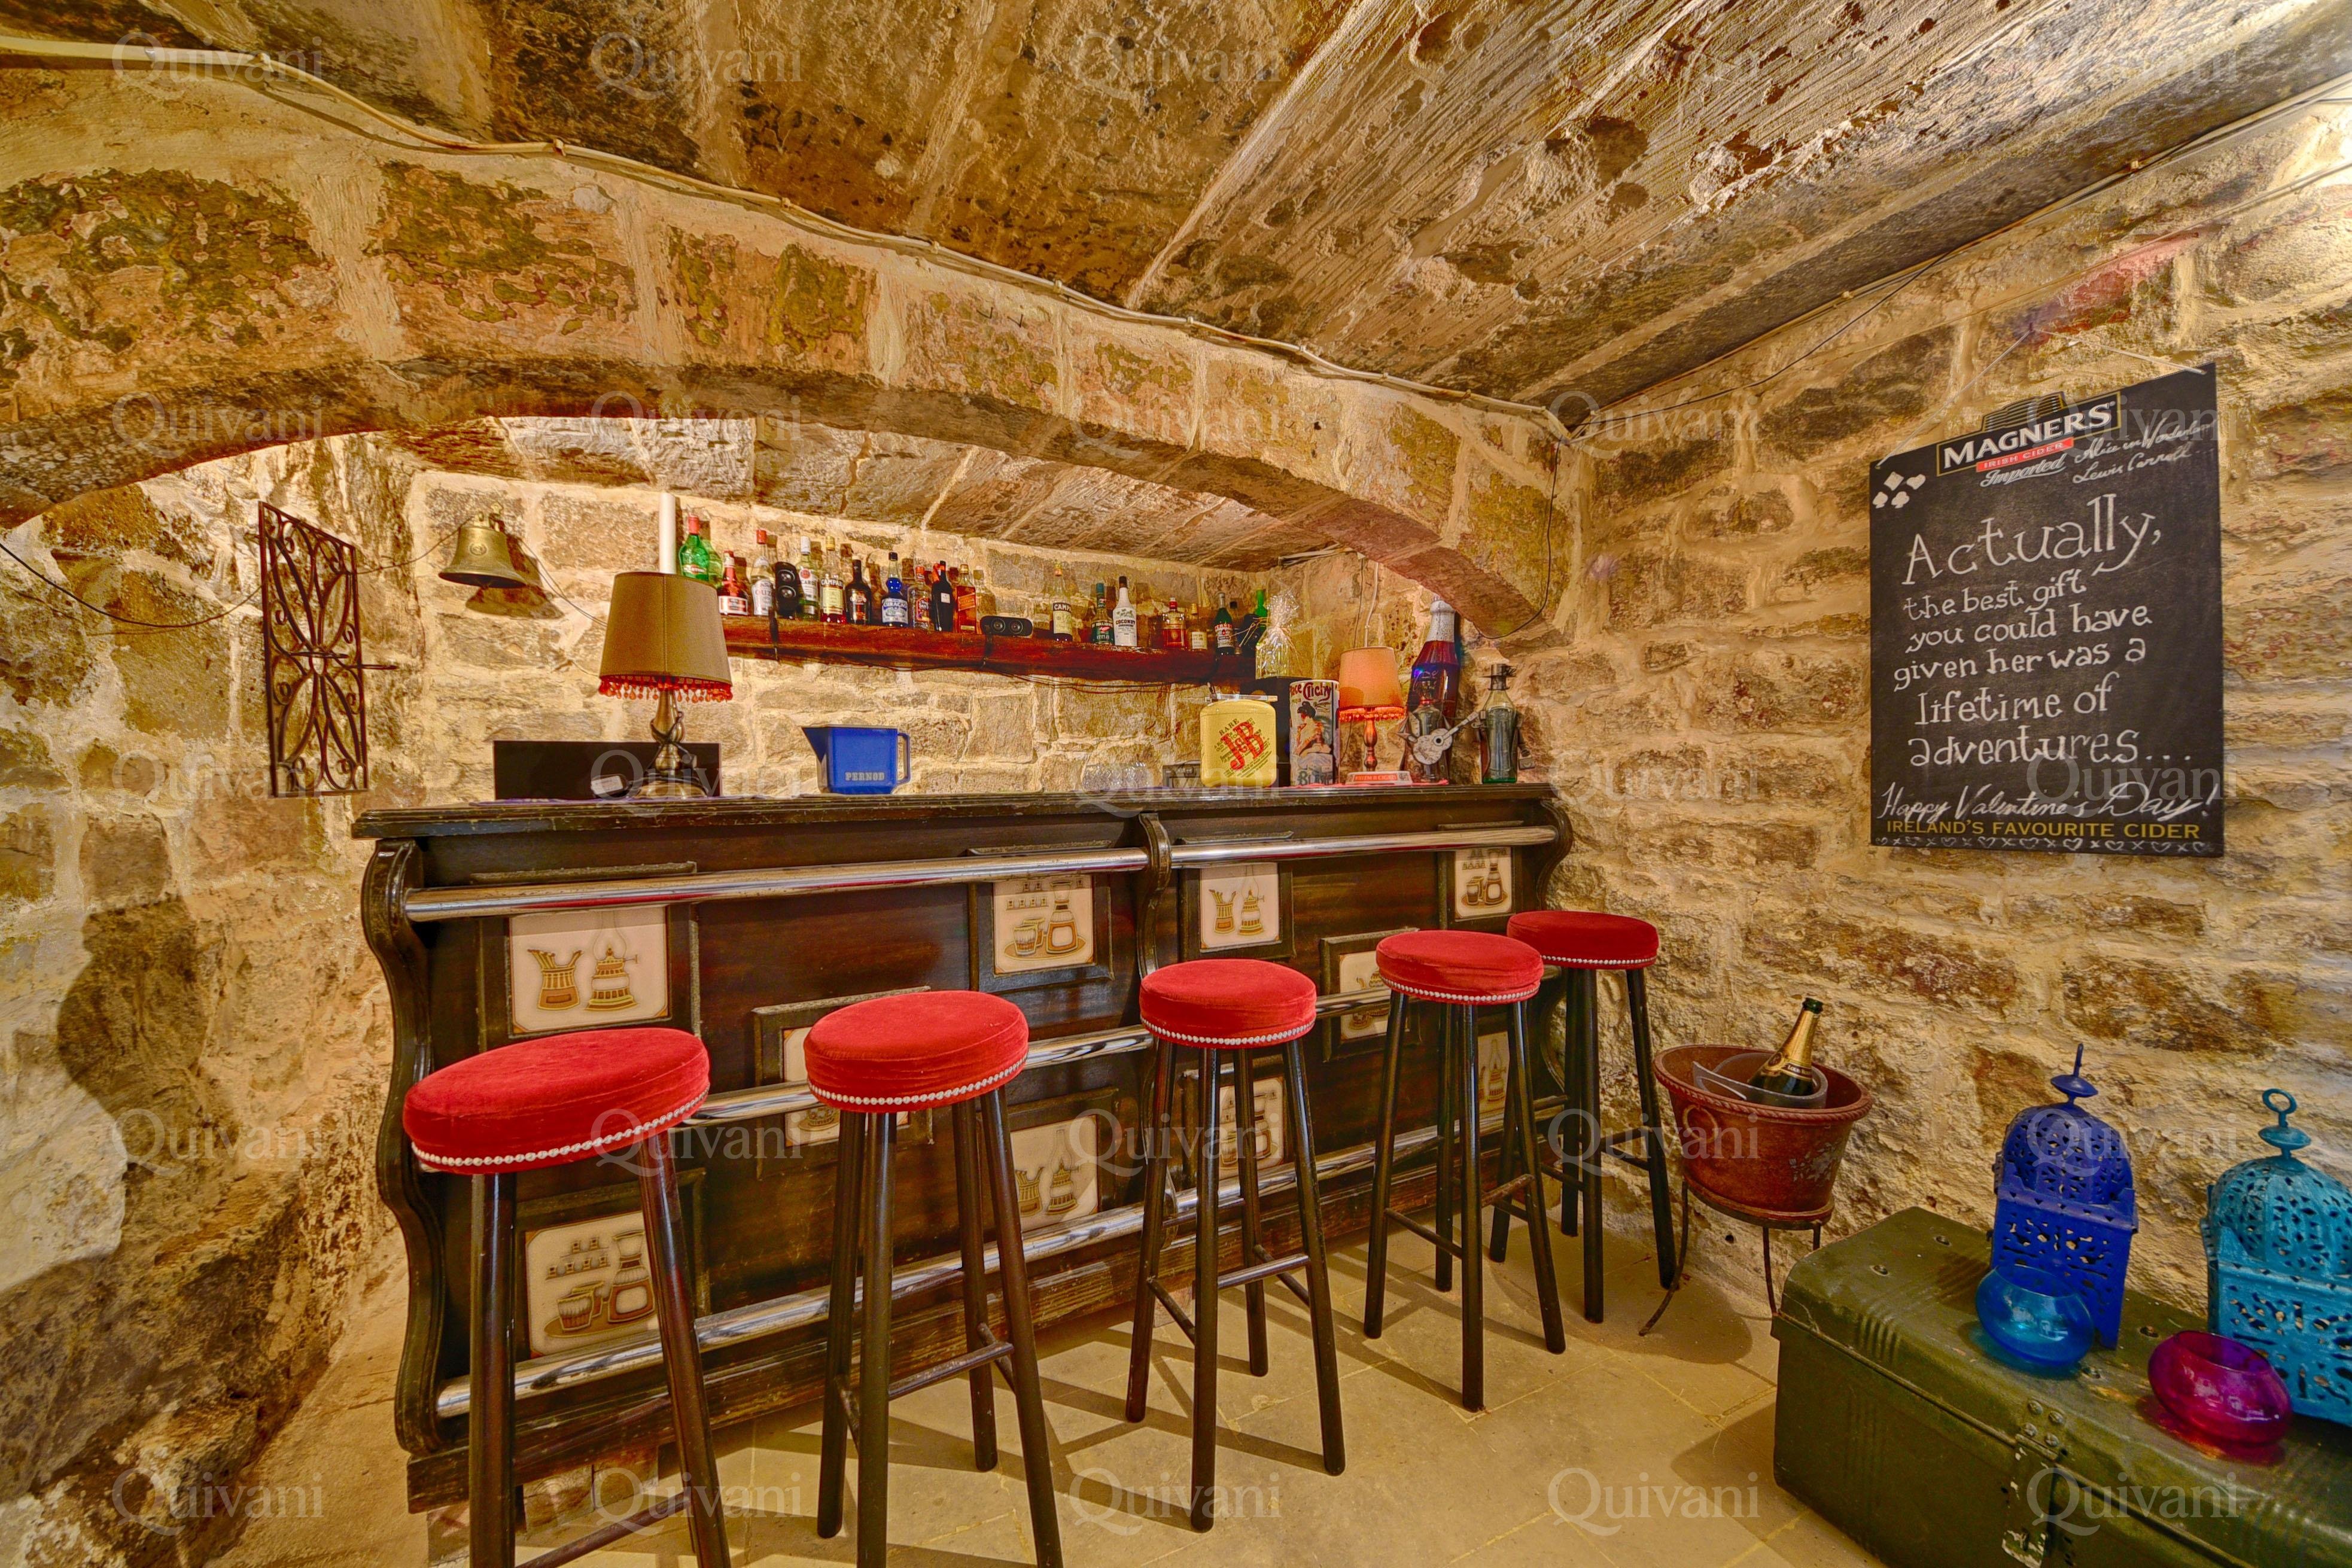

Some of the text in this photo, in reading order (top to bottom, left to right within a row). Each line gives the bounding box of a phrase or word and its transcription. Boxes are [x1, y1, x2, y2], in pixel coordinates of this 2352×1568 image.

[1943, 401, 2113, 469] MAGNERS
[1983, 442, 2064, 468] IRISH CIDER
[2074, 437, 2121, 464] Alice
[1980, 453, 2068, 488] Imported
[2073, 461, 2123, 484] Lewis
[1901, 494, 2162, 586] Actually,
[1903, 568, 2088, 622] the best gift
[1904, 602, 2153, 654] you could have
[1894, 638, 2147, 692] given her was a
[1914, 671, 2121, 726] lifetime of
[845, 771, 886, 781] PERNOD
[1876, 780, 2221, 823] Happy Valentine's Day!
[1886, 820, 2201, 840] IRELAND'S FAVOURITE CIDER
